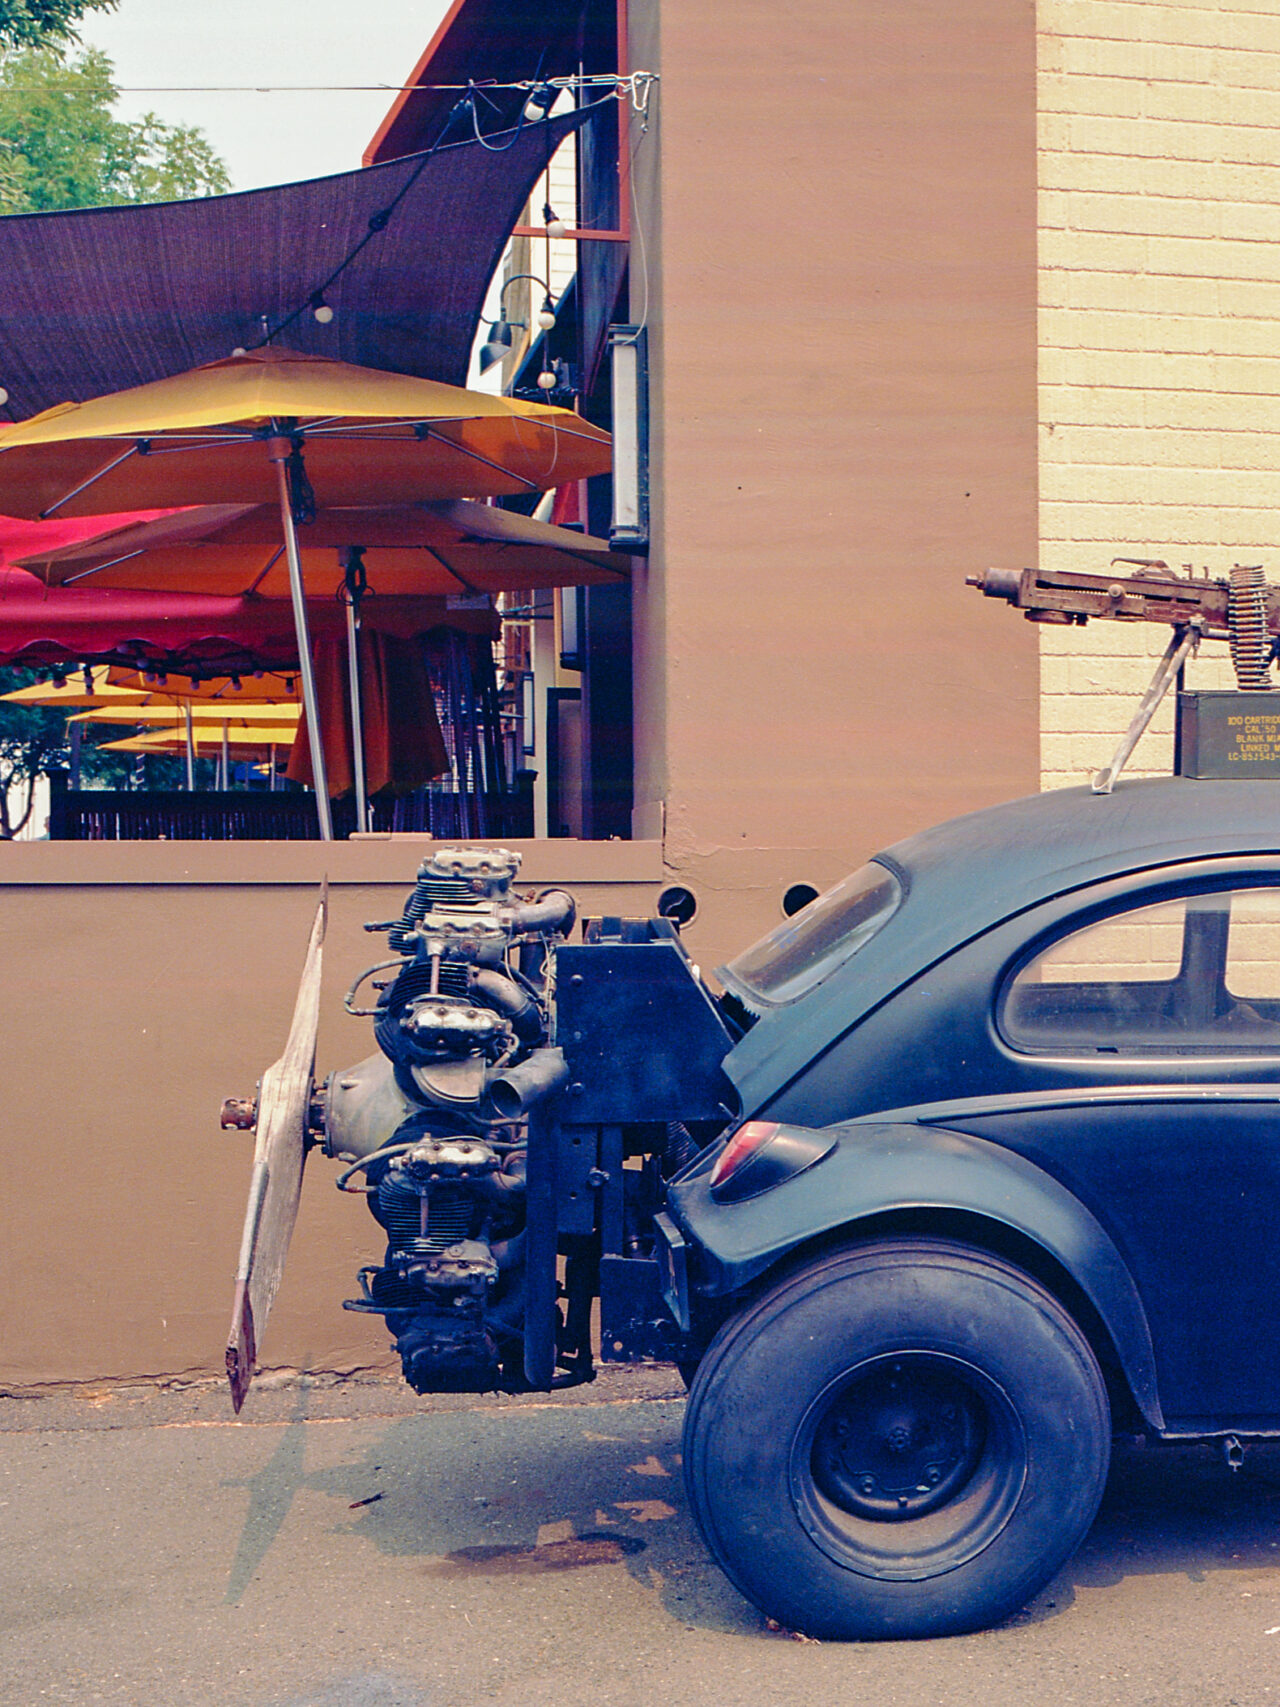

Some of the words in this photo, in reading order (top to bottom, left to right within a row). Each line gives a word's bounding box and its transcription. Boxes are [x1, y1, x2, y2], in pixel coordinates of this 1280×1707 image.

[1227, 716, 1243, 726] 100
[1235, 734, 1265, 743] BLANK
[1240, 743, 1270, 752] LINKED
